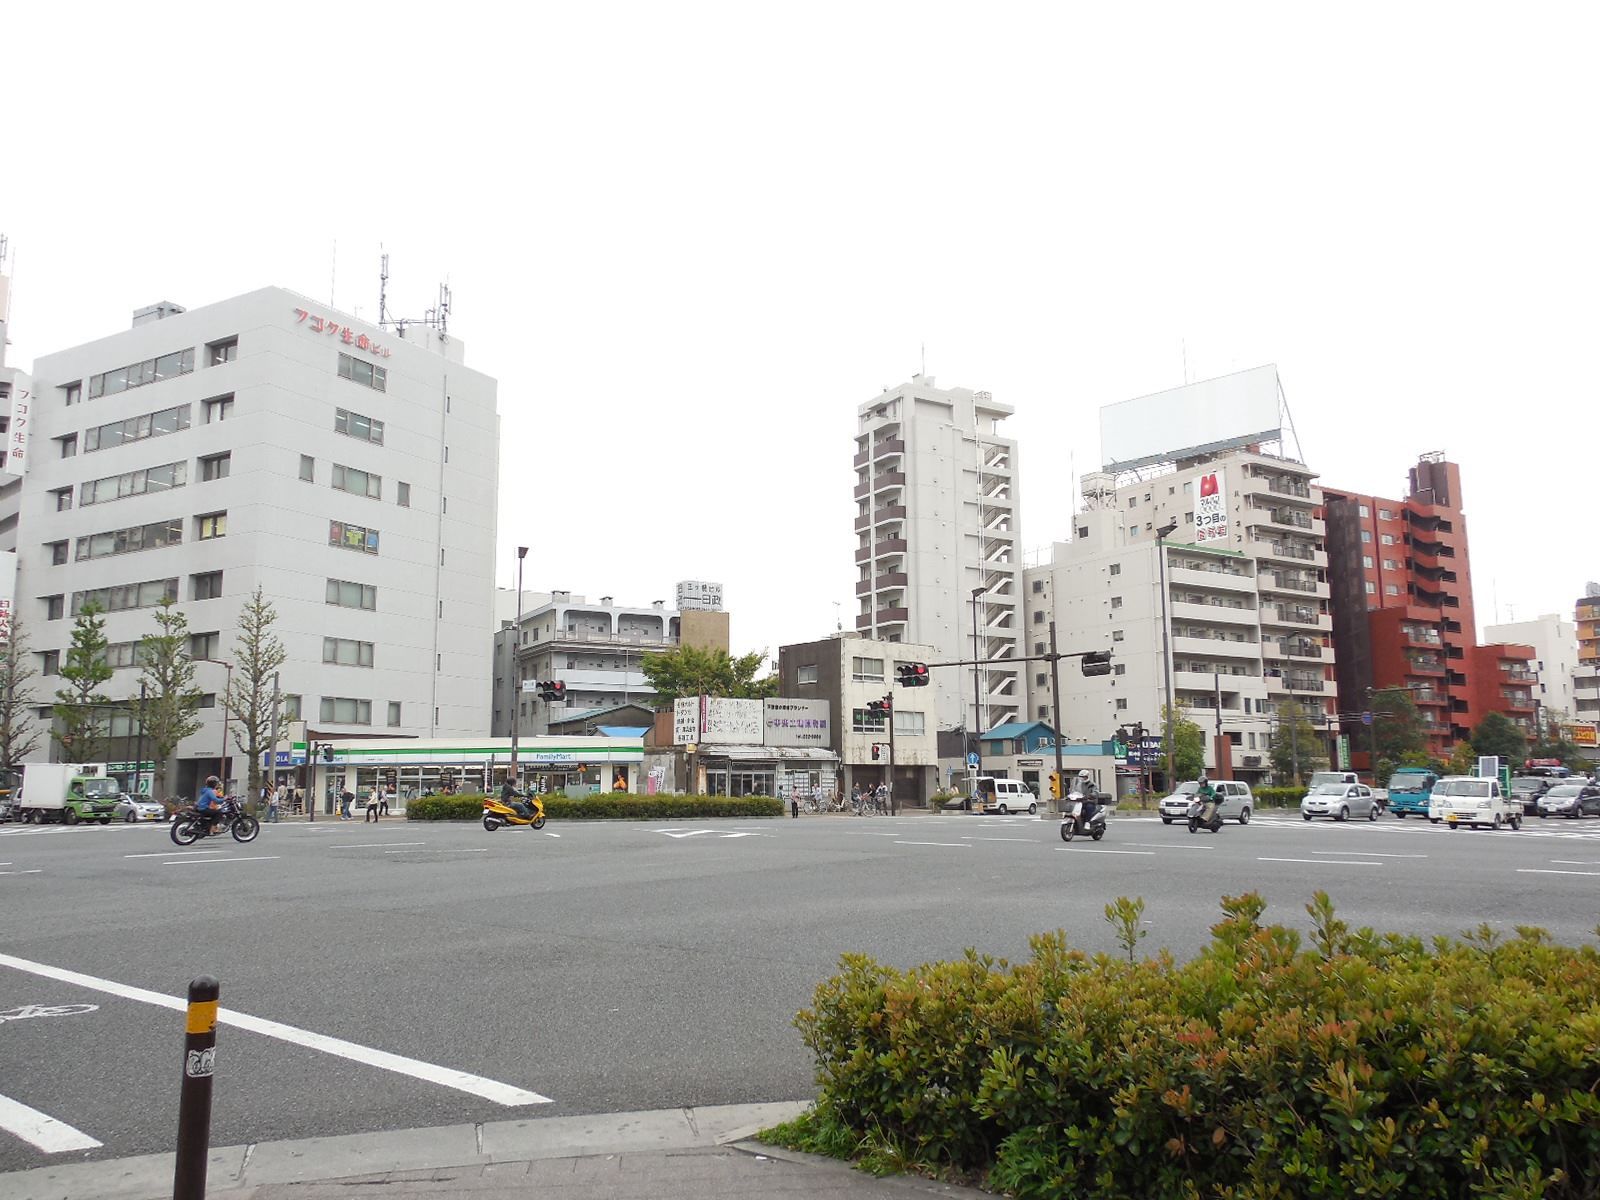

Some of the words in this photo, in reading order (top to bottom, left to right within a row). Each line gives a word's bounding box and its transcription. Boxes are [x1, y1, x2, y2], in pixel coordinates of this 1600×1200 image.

[294, 307, 391, 358] フコク生命ビル
[12, 389, 30, 459] フコク生命
[1196, 513, 1227, 527] 3つ目の
[536, 753, 571, 761] FamilyMart
